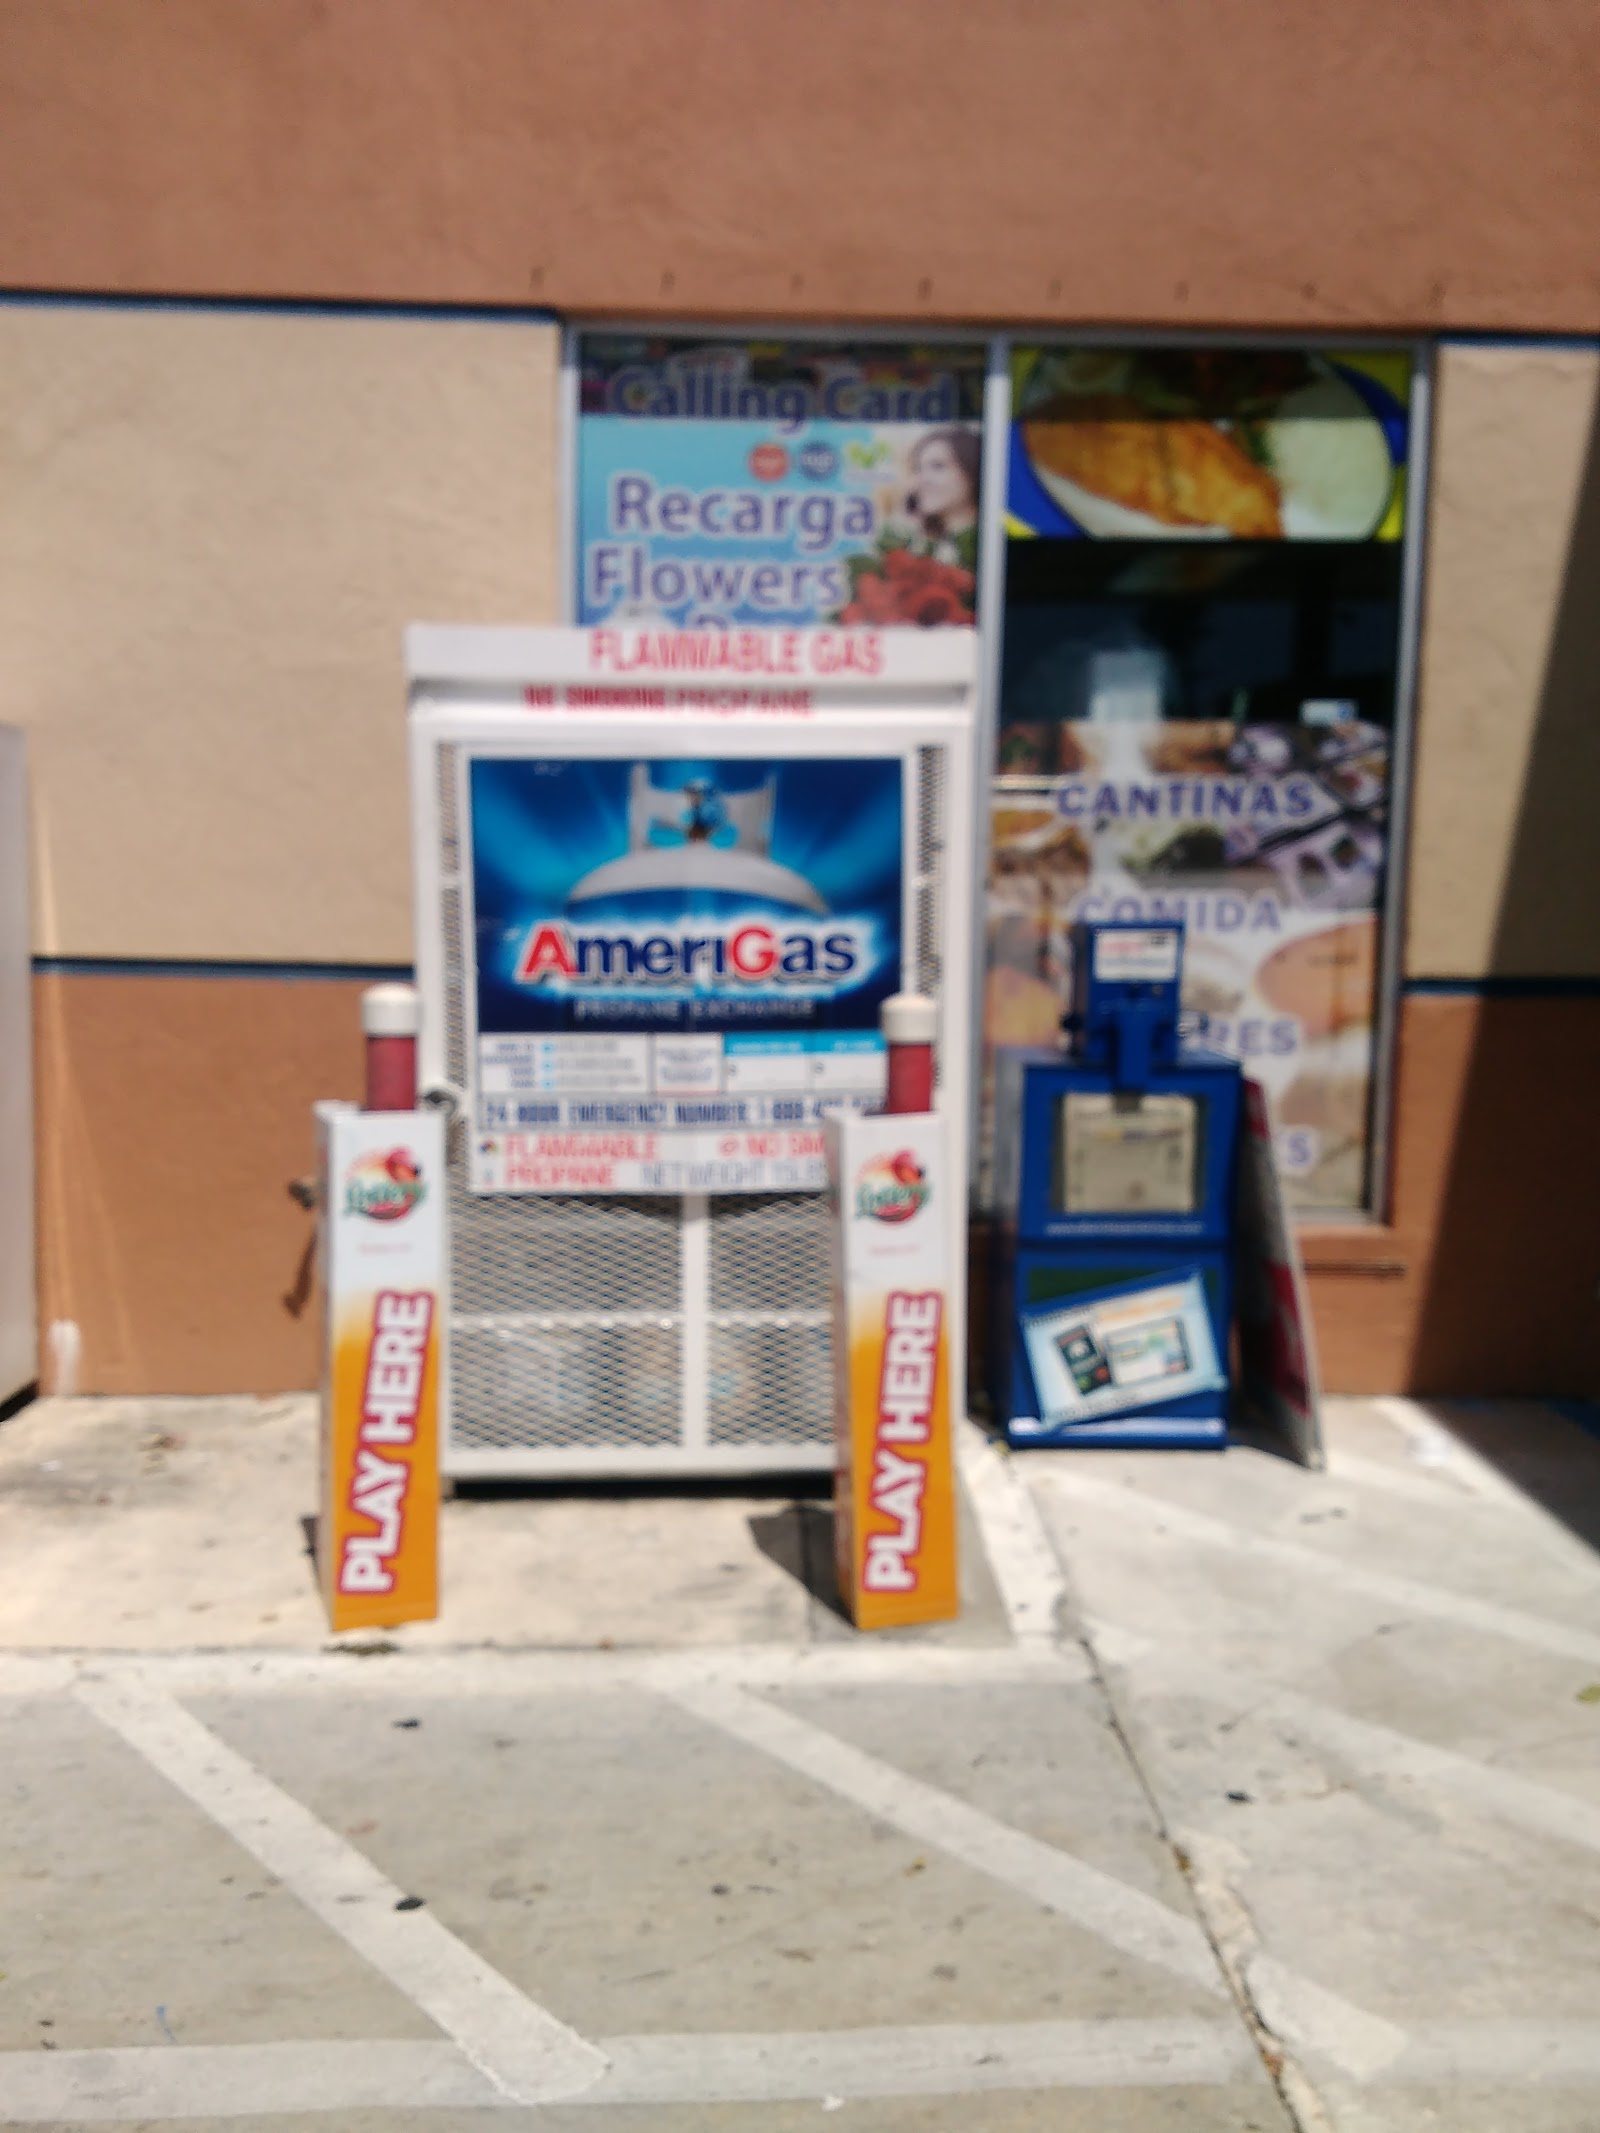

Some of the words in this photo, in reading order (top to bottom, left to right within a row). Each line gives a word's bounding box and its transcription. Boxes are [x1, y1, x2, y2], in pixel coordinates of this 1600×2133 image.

[616, 373, 806, 433] Calling
[825, 376, 958, 422] Card
[614, 476, 875, 550] Recarga
[591, 546, 842, 602] Flowers
[590, 630, 802, 673] FLAMMABLE
[811, 632, 884, 676] GAS
[1056, 780, 1315, 818] CANTINAS
[1076, 896, 1281, 931] COMIDA
[521, 924, 857, 977] AmeriGas
[360, 1291, 433, 1444] HERE
[877, 1291, 942, 1443] HERE
[339, 1446, 408, 1593] PLAY
[864, 1446, 926, 1591] PLAY
